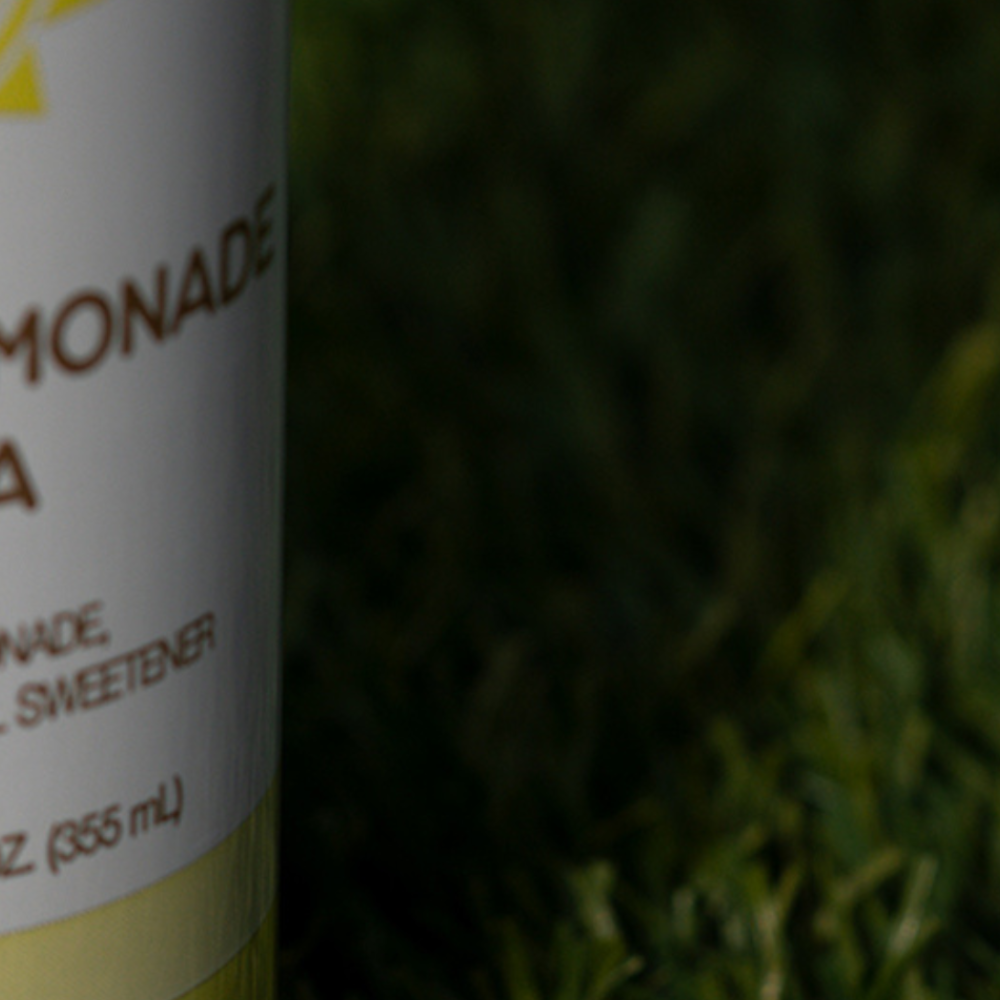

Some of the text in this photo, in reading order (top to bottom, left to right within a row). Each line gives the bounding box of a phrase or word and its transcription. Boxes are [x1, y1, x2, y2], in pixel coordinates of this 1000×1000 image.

[15, 611, 217, 730] SWEETENER
[46, 802, 123, 876] (355
[130, 774, 184, 838] mL)
